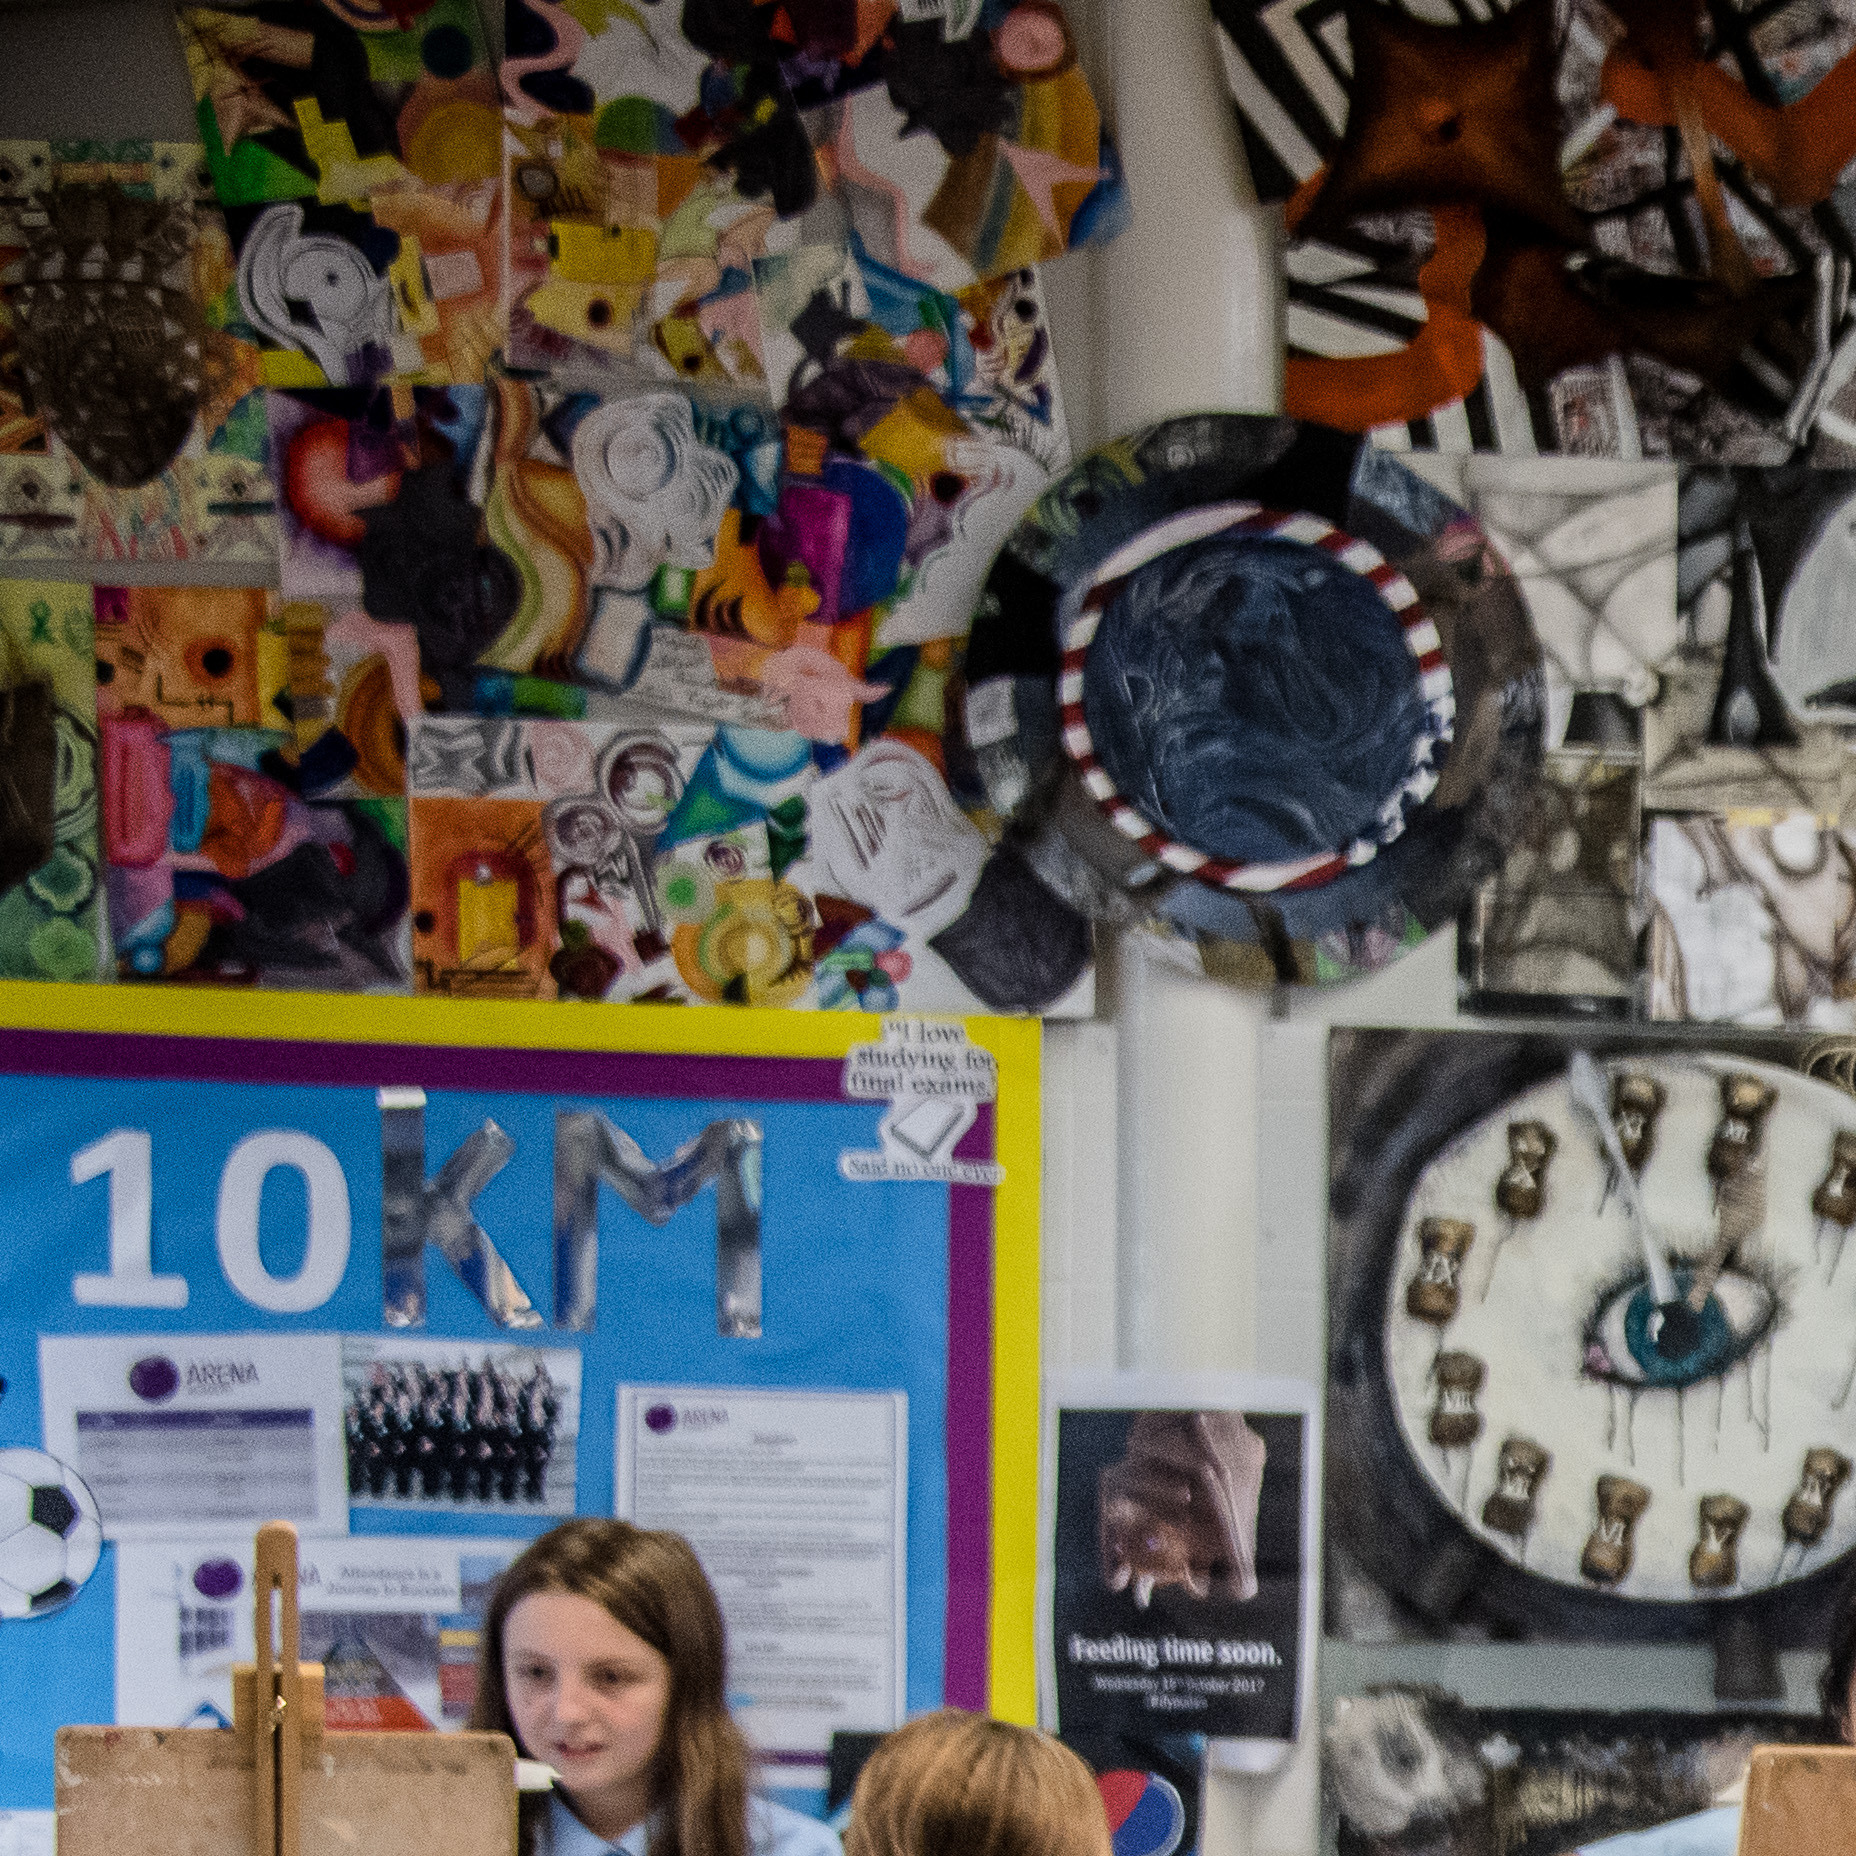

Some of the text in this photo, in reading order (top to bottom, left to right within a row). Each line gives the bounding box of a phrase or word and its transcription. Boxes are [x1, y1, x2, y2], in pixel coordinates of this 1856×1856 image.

[918, 1022, 968, 1043] love
[857, 1048, 956, 1075] studying
[850, 1071, 903, 1092] final
[849, 1160, 889, 1175] Said
[894, 1163, 918, 1176] no
[922, 1164, 952, 1177] one
[186, 1362, 259, 1385] ARENA
[1072, 1634, 1283, 1670] Feeding time soon.
